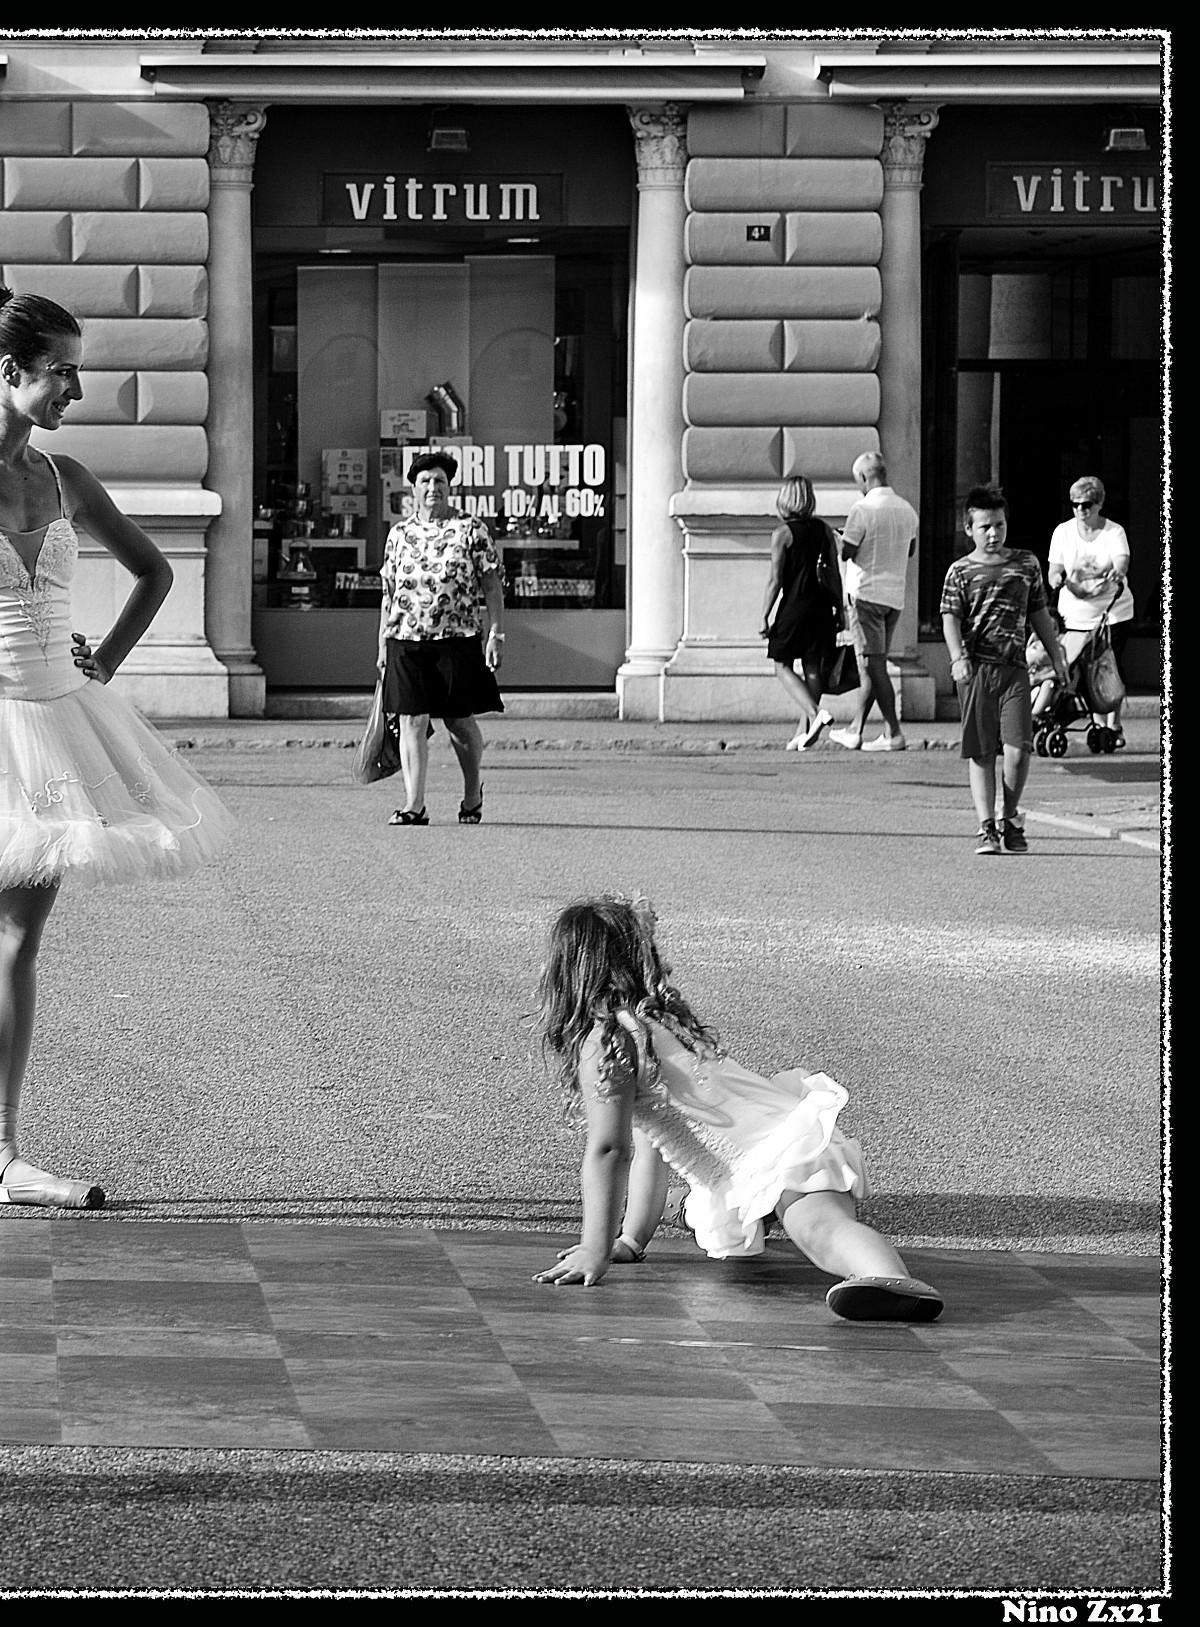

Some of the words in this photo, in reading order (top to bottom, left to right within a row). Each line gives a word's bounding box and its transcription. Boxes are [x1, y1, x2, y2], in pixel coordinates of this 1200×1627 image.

[346, 176, 540, 219] vitrum
[402, 445, 495, 487] FORI
[502, 444, 605, 486] TUTTO
[465, 495, 499, 517] DAL
[502, 489, 536, 517] 10%
[540, 494, 562, 517] AL
[565, 488, 604, 517] 60%
